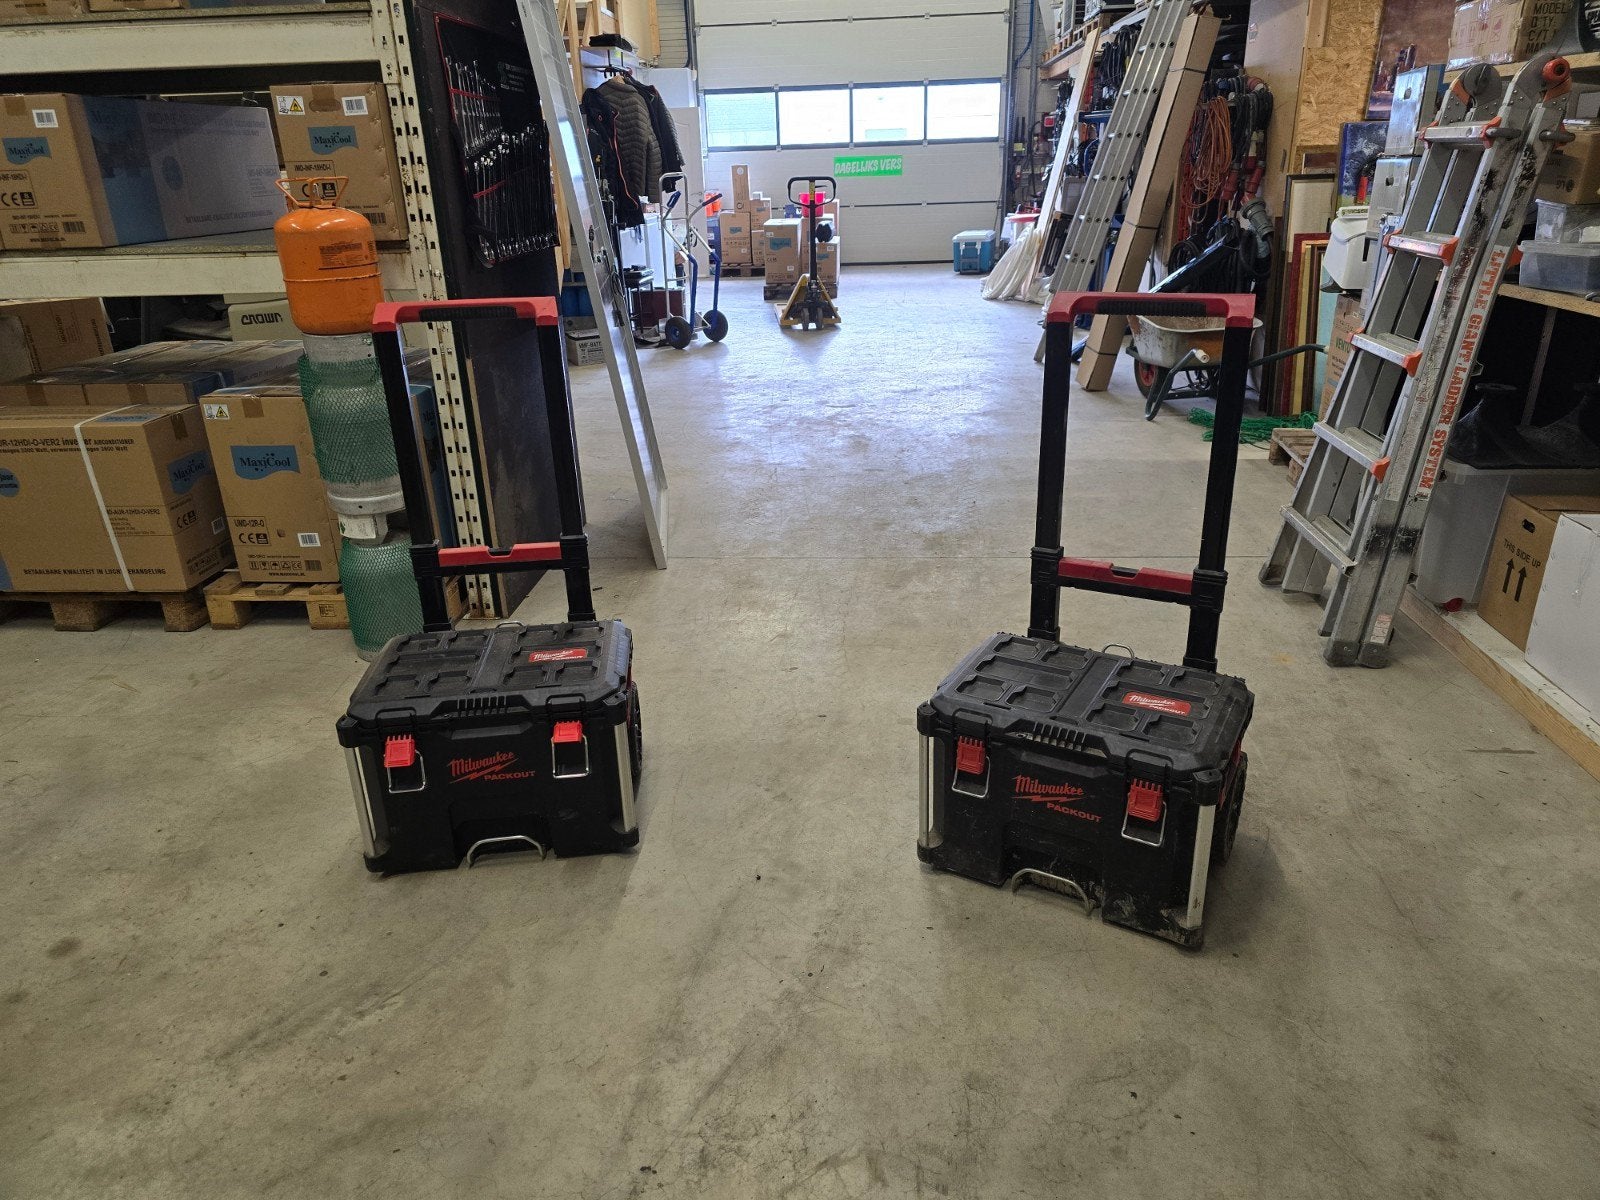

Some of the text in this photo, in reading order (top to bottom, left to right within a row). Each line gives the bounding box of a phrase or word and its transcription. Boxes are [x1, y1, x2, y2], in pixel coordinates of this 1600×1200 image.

[1534, 2, 1568, 15] MODEL
[314, 136, 352, 145] MaxiCool
[8, 145, 45, 156] MaxiCool
[834, 158, 902, 175] DAGELIJKS VERS
[1474, 250, 1506, 309] LITTLE
[1458, 313, 1483, 364] GIANT
[1438, 364, 1468, 425] LADDER
[240, 456, 291, 468] MaxiCool
[1420, 428, 1448, 490] SYSTEM
[1504, 538, 1541, 568] THIS SIDE UP
[533, 650, 573, 660] Milwaukee
[1129, 694, 1176, 705] Milwaukee
[447, 752, 514, 777] Milwaukee
[484, 770, 535, 781] PACKOUT
[1012, 774, 1084, 796] Milwaukee
[1047, 802, 1102, 822] PACKOUT
